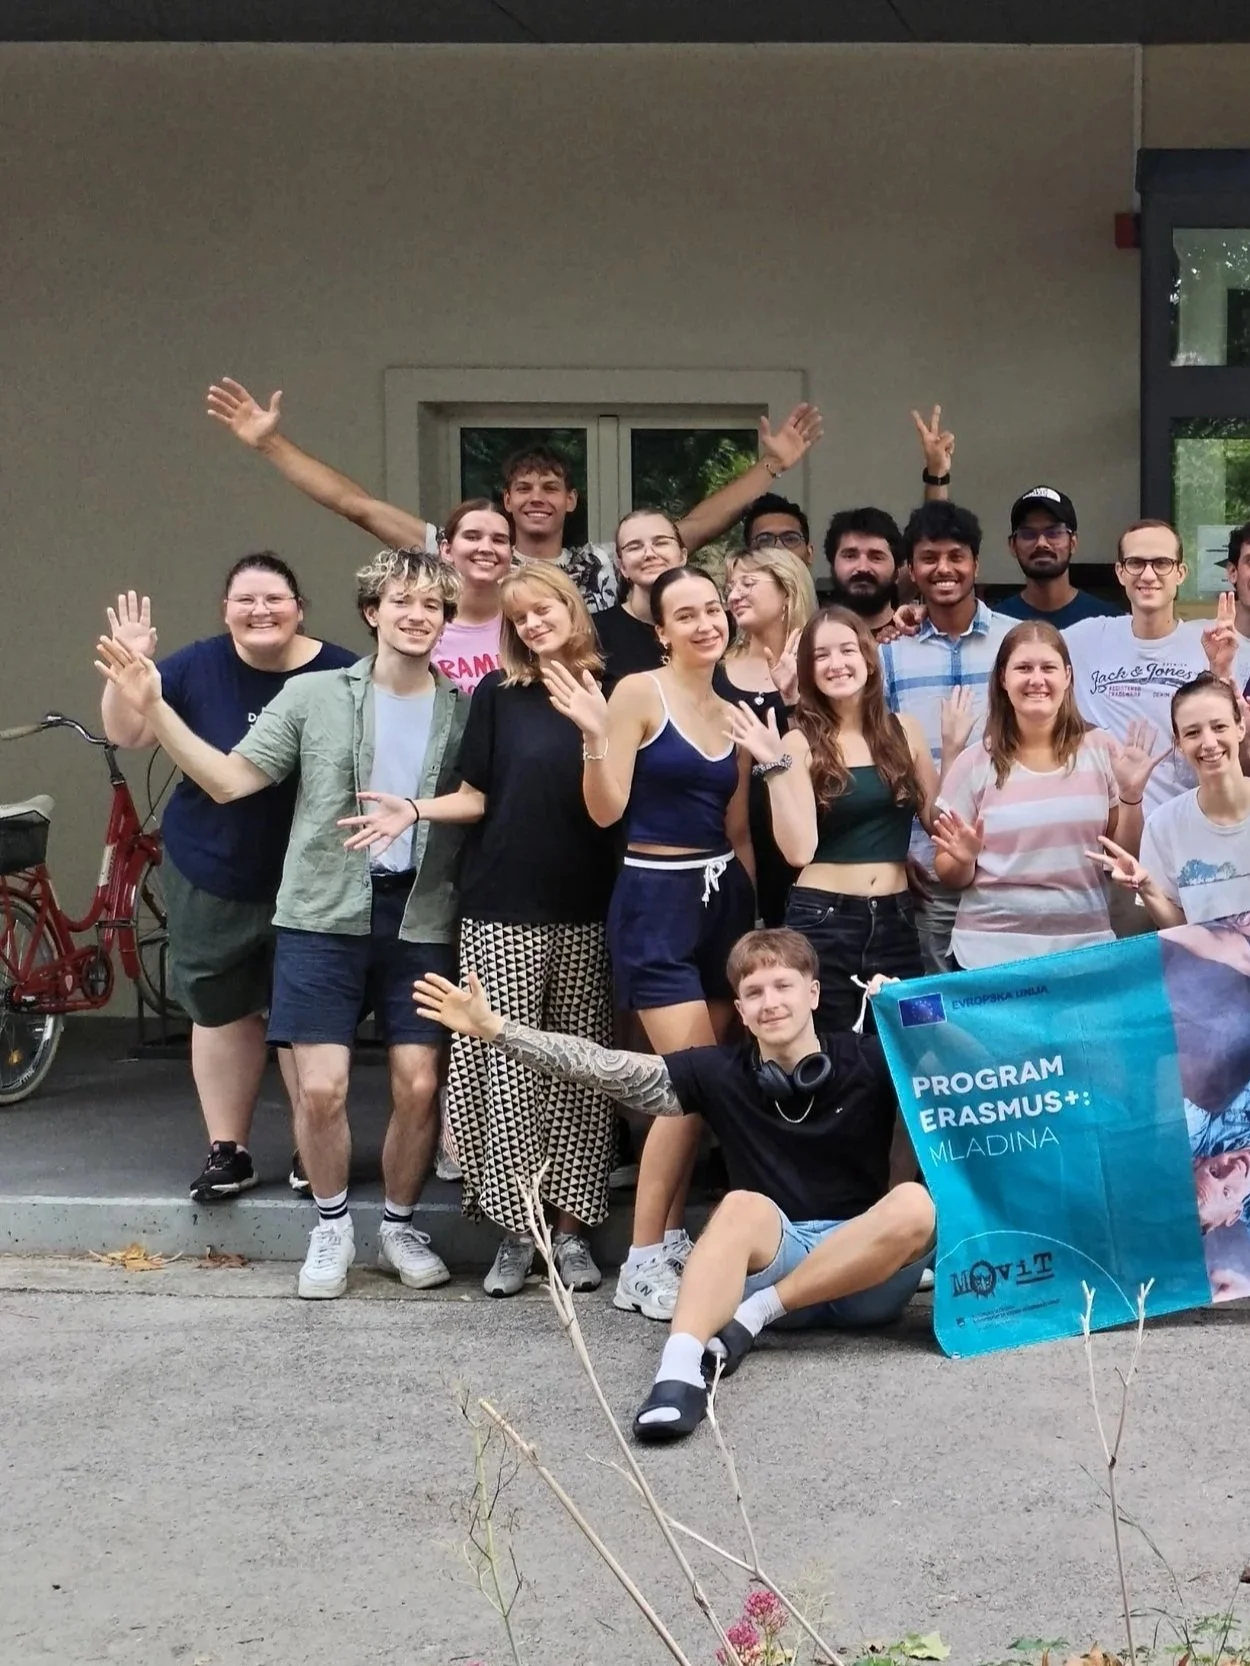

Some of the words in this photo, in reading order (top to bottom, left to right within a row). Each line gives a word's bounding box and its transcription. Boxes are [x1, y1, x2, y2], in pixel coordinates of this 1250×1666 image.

[1090, 666, 1128, 695] Jack
[1130, 666, 1143, 678] &
[1140, 662, 1192, 685] Jones
[952, 992, 1013, 1010] EVROPSKA
[1015, 985, 1049, 998] UNIJA
[912, 1055, 1064, 1099] PROGRAM
[919, 1090, 1090, 1134] ERASMUS+:
[929, 1126, 1060, 1168] MLADINA
